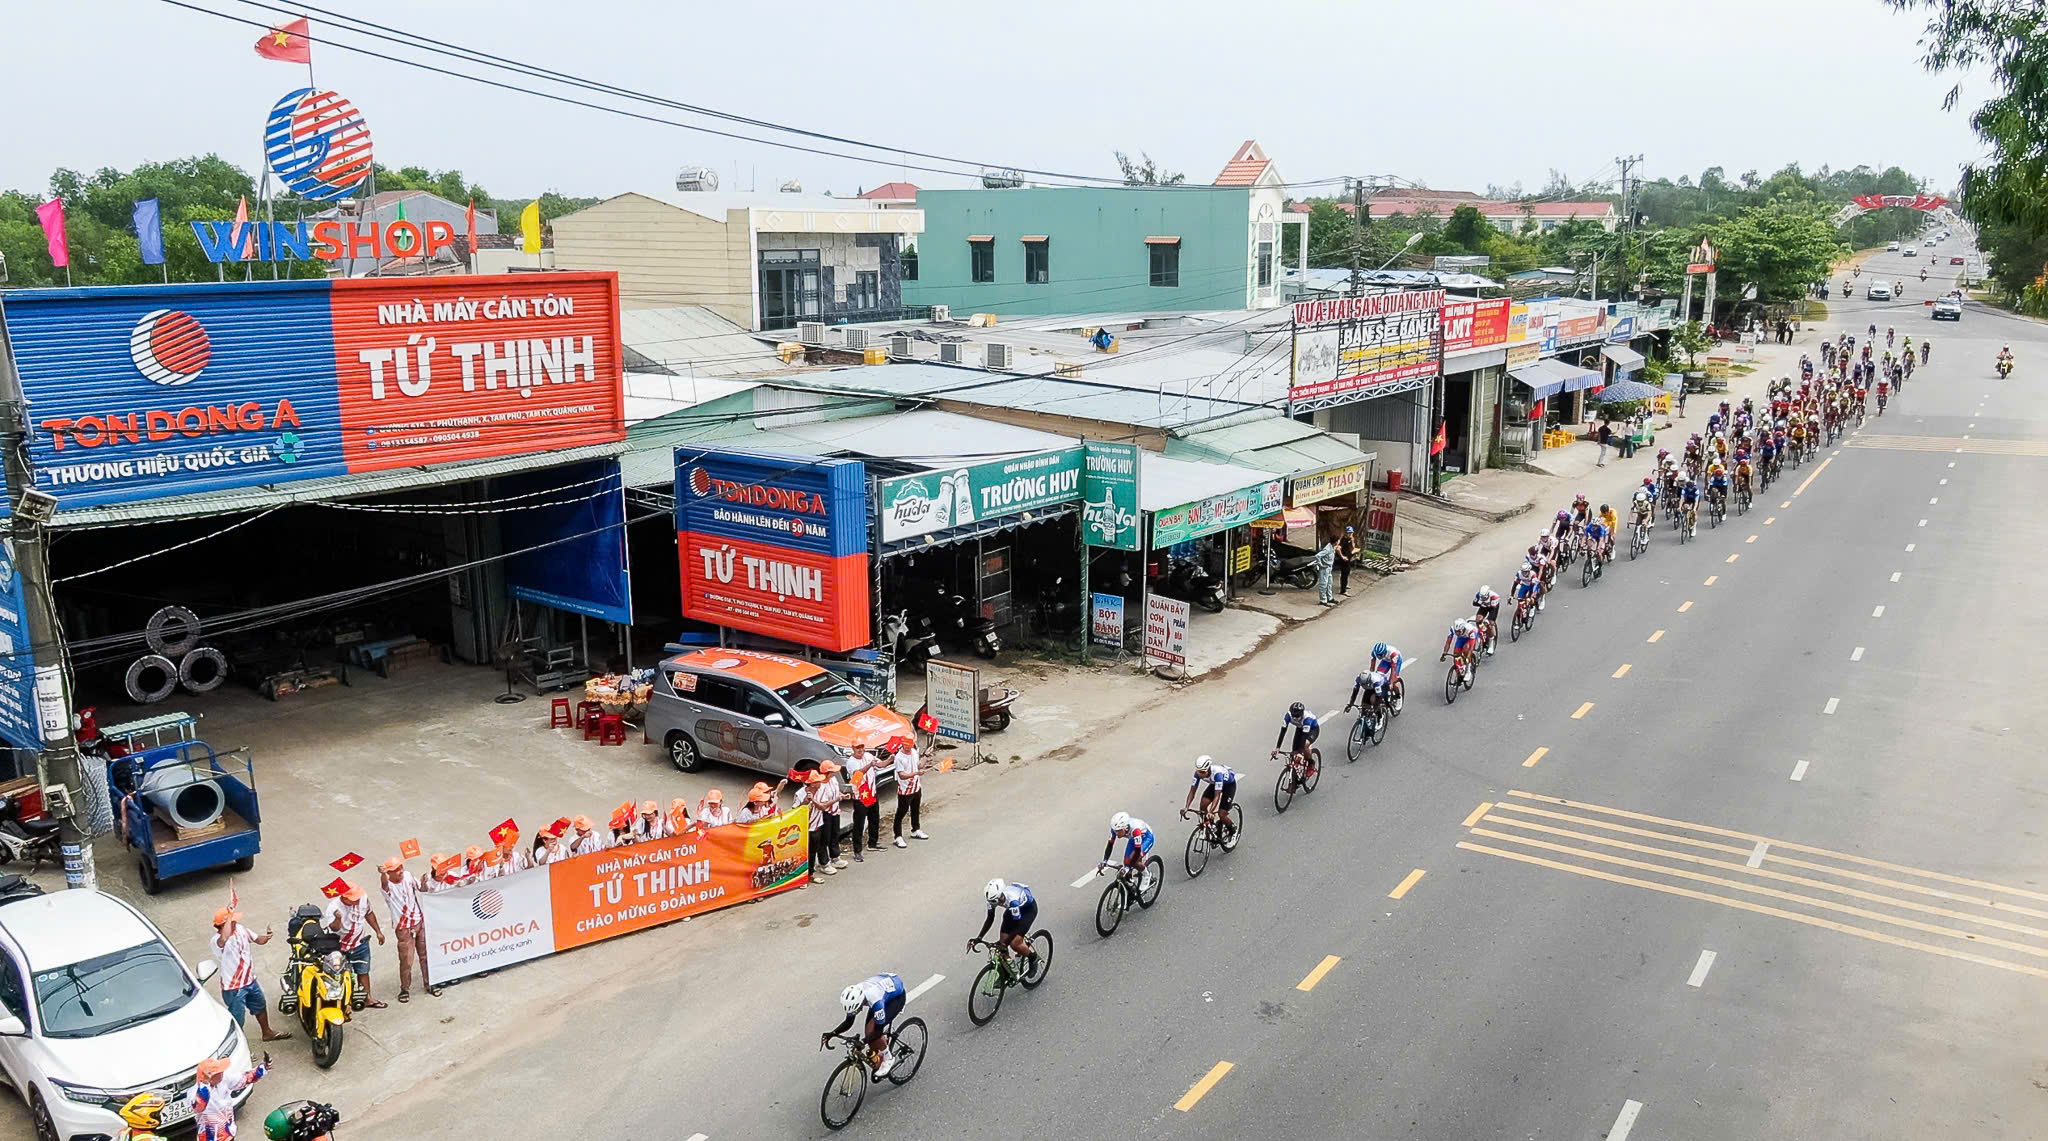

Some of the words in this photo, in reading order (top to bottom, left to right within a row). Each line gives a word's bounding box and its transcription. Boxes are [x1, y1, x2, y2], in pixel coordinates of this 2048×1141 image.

[190, 220, 455, 262] WINSHOP
[378, 298, 428, 325] NHÀ
[433, 296, 478, 323] MÁY
[483, 295, 527, 320] CÁN
[531, 293, 573, 317] TÔN
[1421, 289, 1446, 310] NAM
[1444, 317, 1473, 340] LMT
[359, 334, 436, 400] TỨ
[451, 335, 595, 398] THỊNH
[41, 412, 140, 451] TON
[147, 401, 264, 441] DONG
[272, 399, 302, 429] A
[49, 460, 134, 486] THƯƠNG
[137, 453, 180, 478] HIỆU
[184, 445, 236, 471] QUỐC
[240, 446, 270, 464] GIA
[1086, 455, 1117, 473] TRƯỜNG
[1118, 459, 1133, 475] HUY
[1328, 469, 1354, 489] THẢO
[712, 479, 751, 503] TON
[753, 485, 808, 512] DONG
[809, 493, 826, 515] A
[981, 475, 1046, 509] TRƯỜNG
[1049, 468, 1080, 495] HUY
[714, 508, 731, 522] BẢO
[732, 510, 755, 526] HÀNH
[756, 514, 771, 529] LÊN
[772, 516, 789, 532] ĐẾN
[791, 522, 803, 533] 50
[806, 524, 826, 537] NĂM
[700, 544, 736, 583] TỨ
[743, 556, 823, 602] THỊNH
[1150, 599, 1170, 612] QUÁN
[1150, 613, 1164, 624] CƠM
[596, 858, 621, 876] NHÀ
[623, 853, 646, 869] MÁY
[649, 848, 672, 865] CÁN
[674, 843, 697, 860] TÔN
[589, 873, 625, 908] TỨ
[633, 859, 711, 896] THỊNH
[576, 913, 614, 933] CHÀO
[617, 902, 657, 921] MỪNG
[660, 892, 696, 912] ĐOÀN
[699, 886, 726, 902] ĐUA
[440, 935, 475, 955] TON
[478, 922, 525, 945] DONG
[528, 919, 540, 933] A
